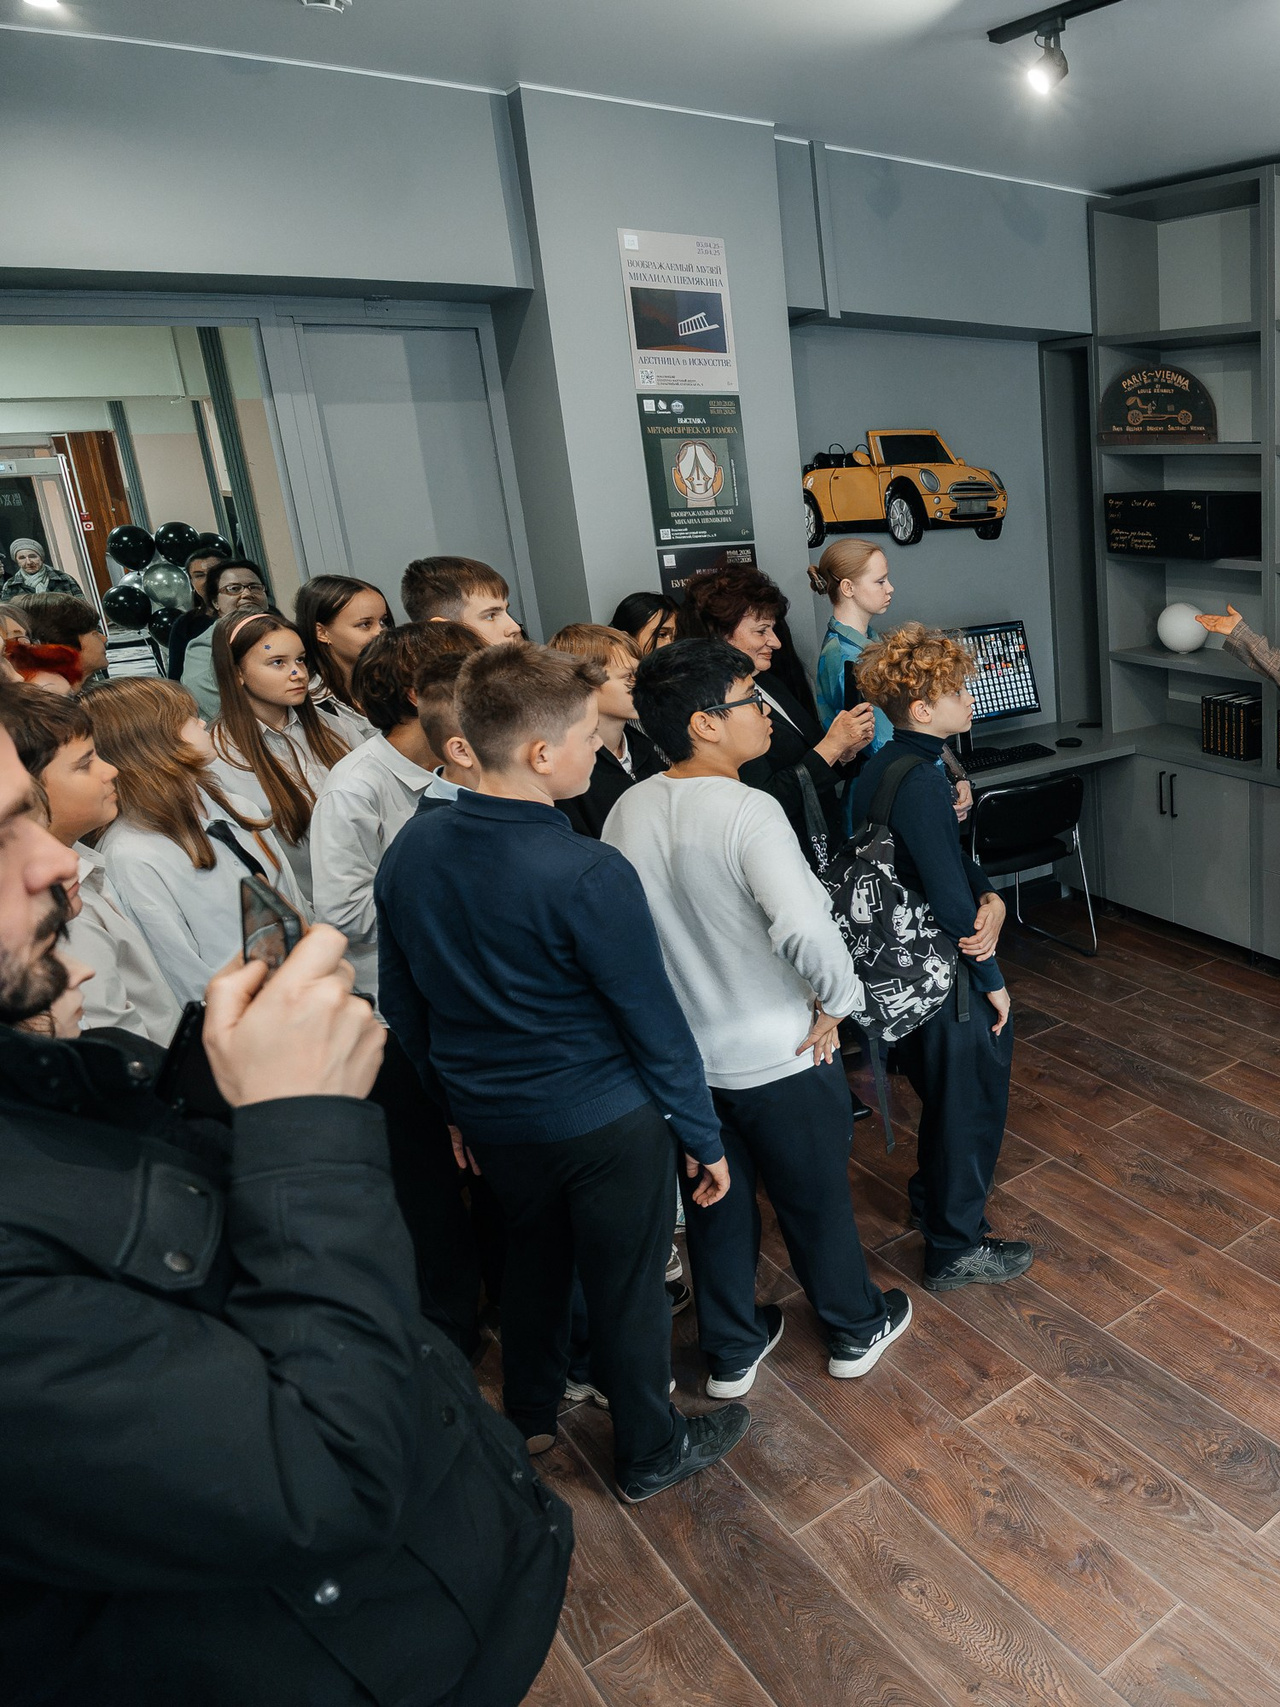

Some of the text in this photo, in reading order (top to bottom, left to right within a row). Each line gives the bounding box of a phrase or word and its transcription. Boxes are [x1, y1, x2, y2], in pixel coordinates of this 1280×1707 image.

[627, 259, 722, 275] ВООБРАЖАЕМЫЙ МУЗЕЙ
[629, 272, 724, 288] МИХАИЛА ШЕМЯКИНА
[638, 356, 681, 366] ЛЕСТНИЦА
[688, 358, 732, 367] ИСКУССТВЕ
